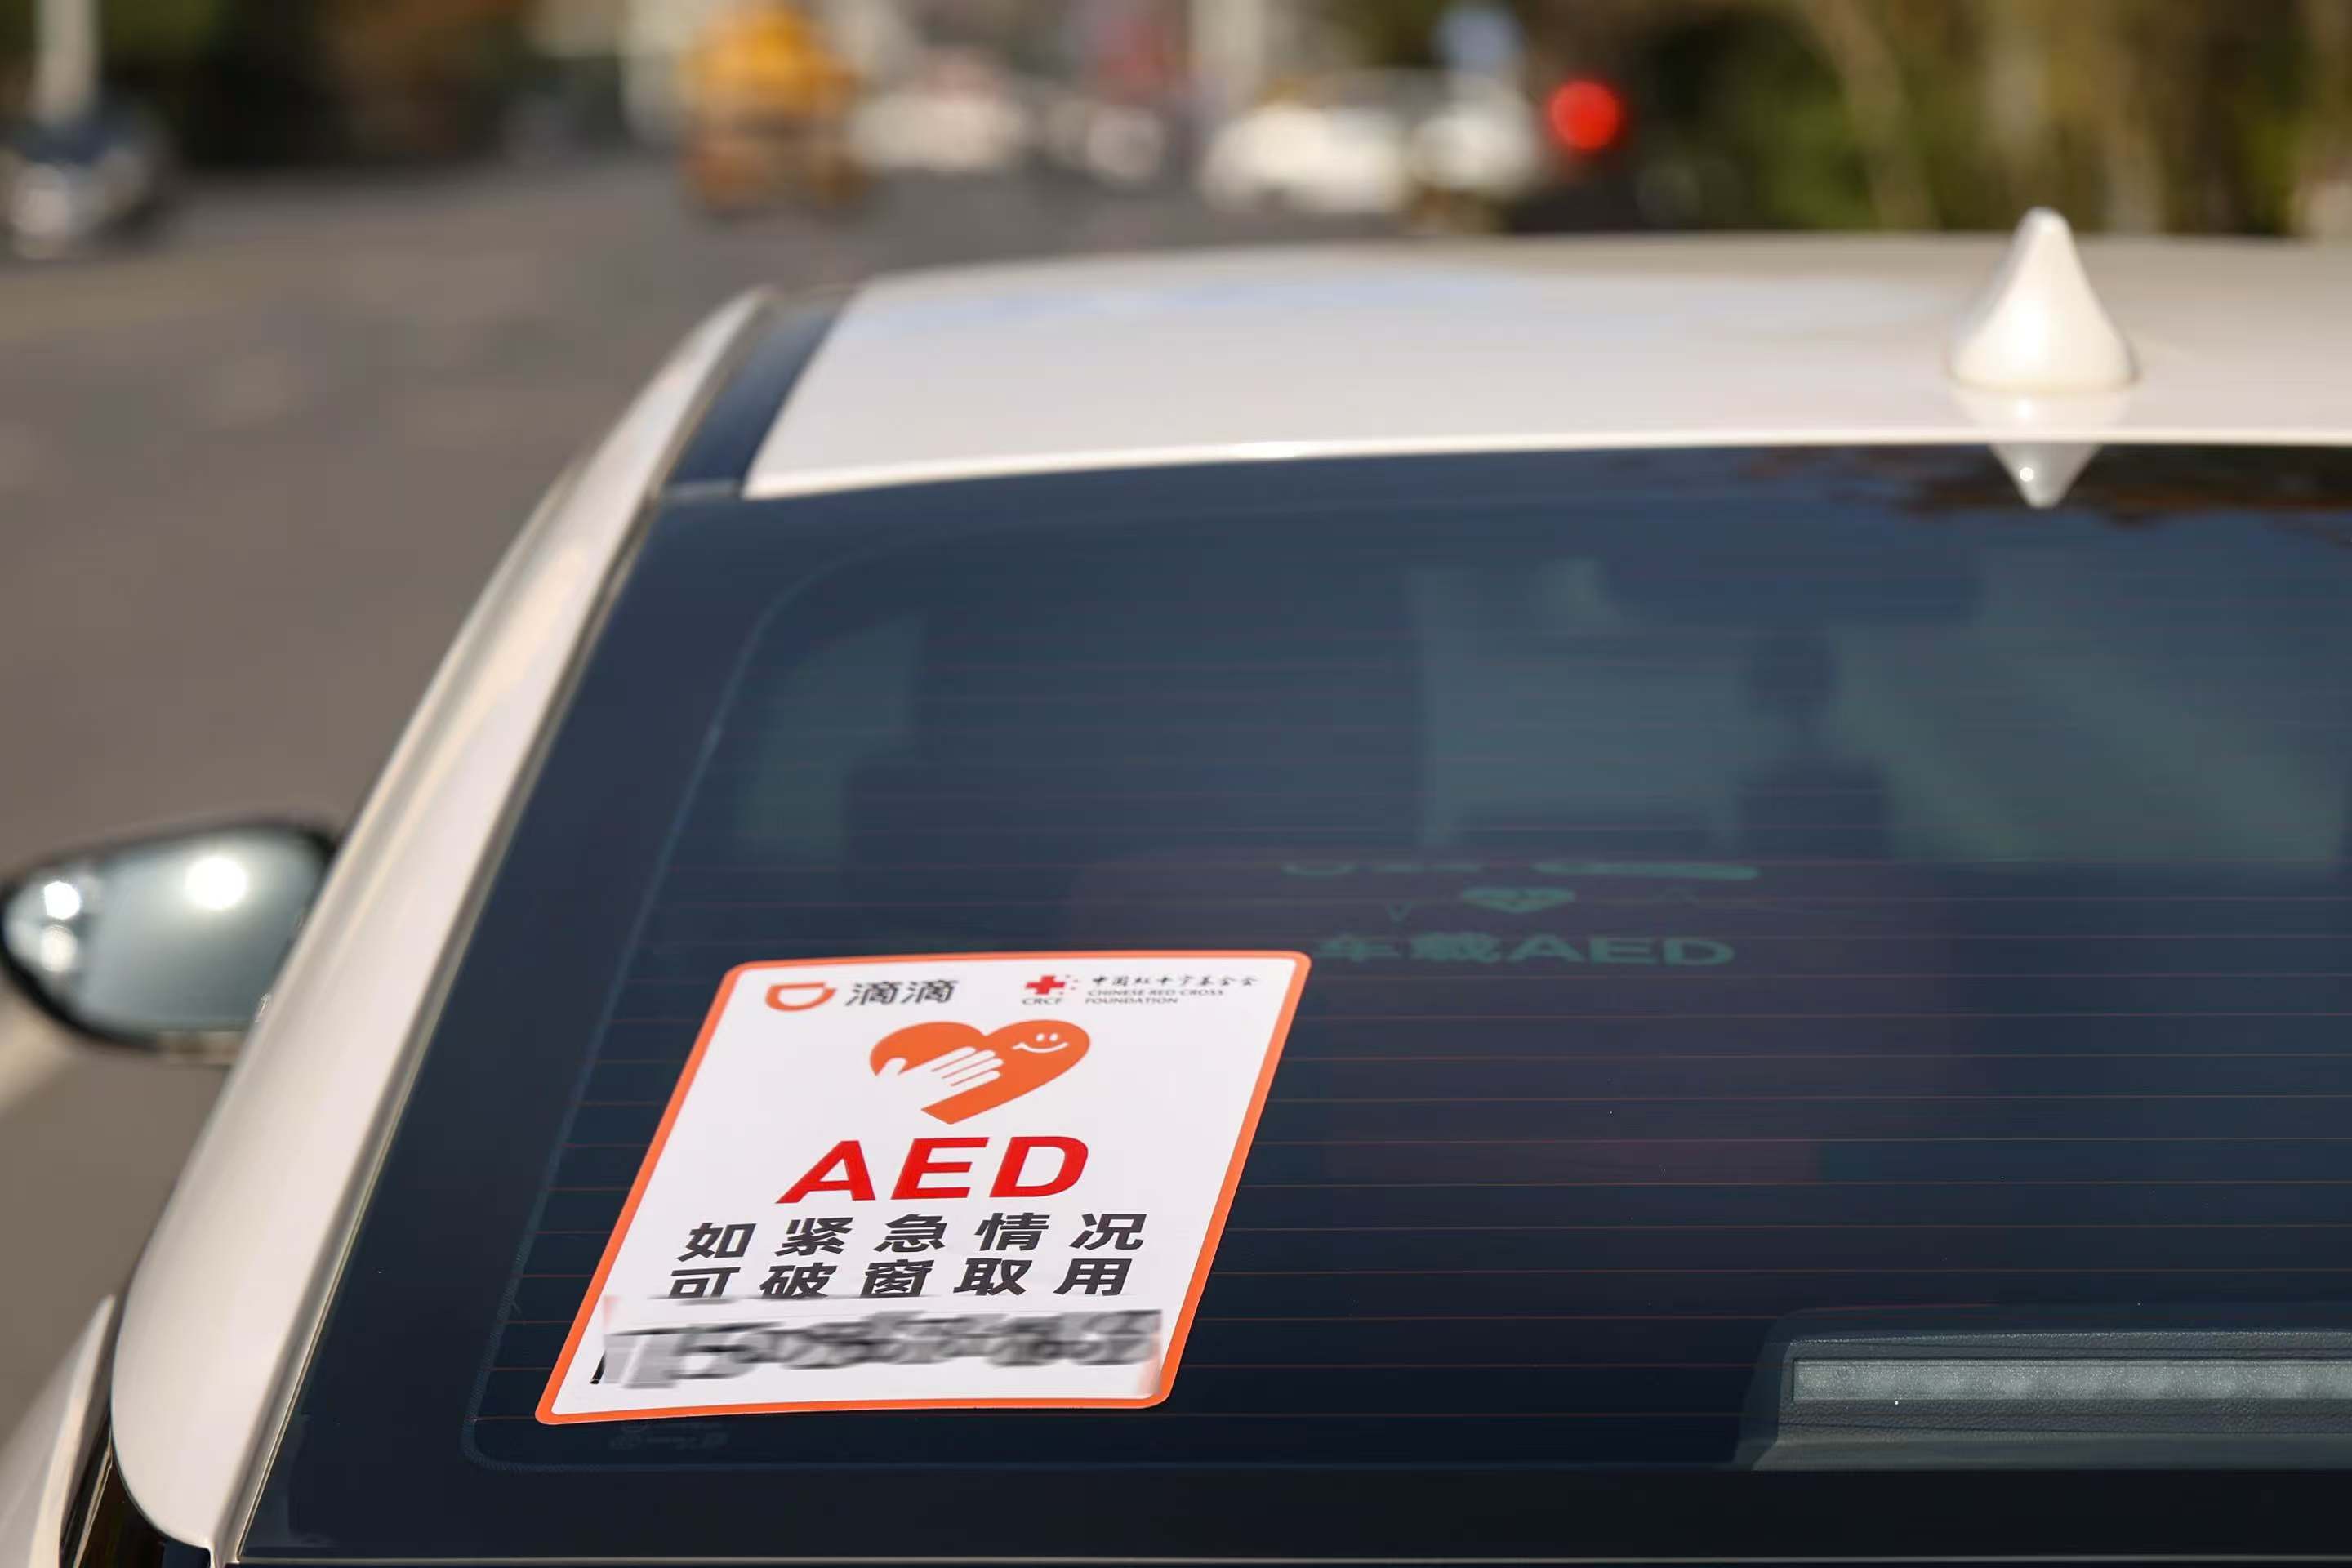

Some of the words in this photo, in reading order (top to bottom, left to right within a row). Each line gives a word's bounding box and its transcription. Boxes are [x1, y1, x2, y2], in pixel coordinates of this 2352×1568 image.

[844, 979, 959, 1007] 滴滴
[1022, 997, 1064, 1005] CRCF
[1085, 996, 1178, 1004] FOUNDATION
[1087, 988, 1144, 996] CHINESE
[1148, 988, 1177, 996] RED
[1179, 988, 1224, 996] CROSS
[775, 1136, 1089, 1204] AED
[677, 1213, 1147, 1262] 如紧急情况
[669, 1258, 1133, 1298] 可破窗取用
